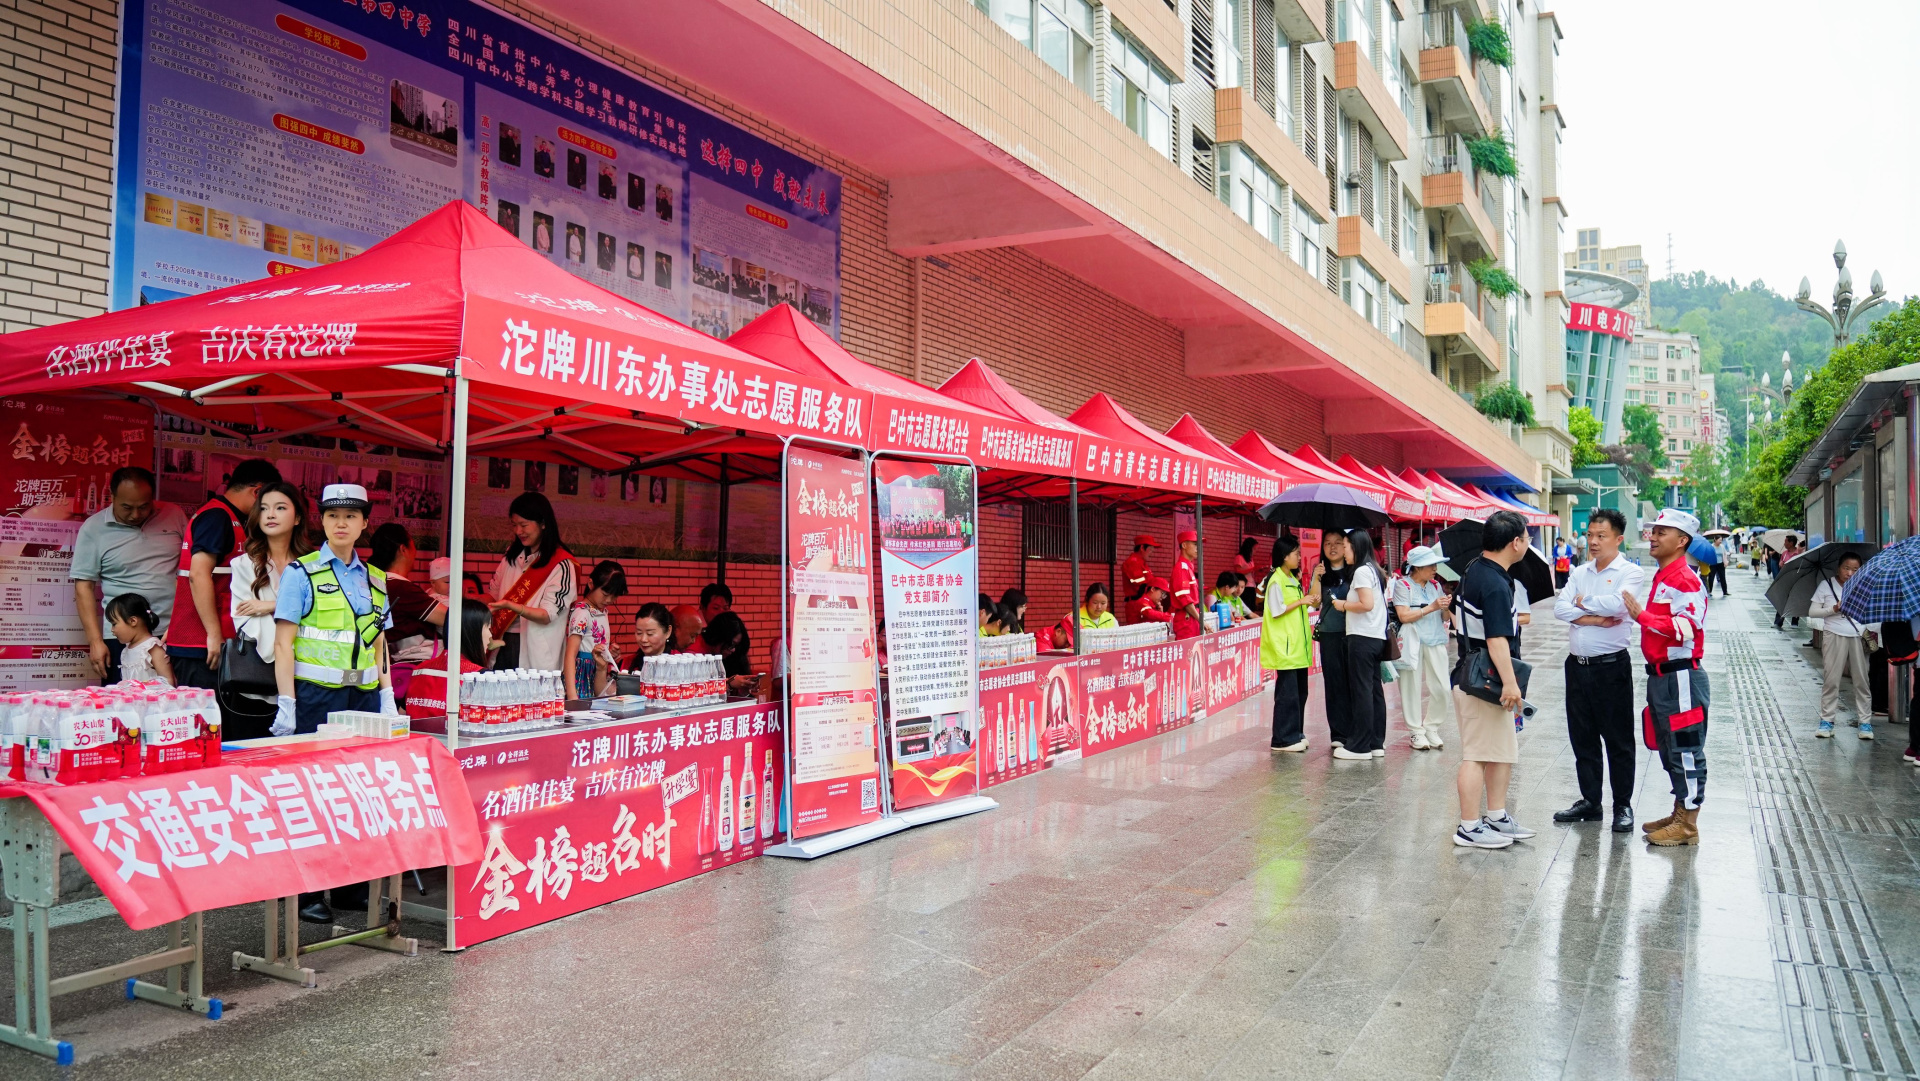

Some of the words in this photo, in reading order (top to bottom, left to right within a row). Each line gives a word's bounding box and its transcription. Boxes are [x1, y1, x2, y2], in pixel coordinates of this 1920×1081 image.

[304, 26, 341, 50] 学校概况
[342, 0, 431, 37] 第四中学
[448, 18, 687, 134] 四川省首批中小学心理健康教育引领校
[448, 46, 687, 158] 四川省中小学跨学科主题学习教师研修实践基地
[279, 116, 319, 138] 图强四中
[322, 128, 359, 152] 成绩斐然
[700, 138, 764, 189] 选择四中
[773, 168, 830, 217] 成就未来
[46, 329, 176, 379] 名酒伴佳宴
[200, 322, 358, 365] 吉庆有沱牌
[500, 317, 863, 440] 沱牌川东办事处志愿服务队
[8, 422, 135, 468] 金榜题名时
[888, 408, 970, 454] 巴中市志愿服务联合会
[980, 425, 1074, 469] 巴中市志愿者协会党员志愿服务队
[14, 478, 65, 493] 沱牌百万
[1085, 444, 1199, 487] 巴中市青年志愿者协会
[20, 493, 69, 506] 助学好礼
[796, 477, 860, 522] 金榜题名时
[801, 532, 827, 546] 沱牌百万
[891, 573, 963, 588] 巴中市志愿者协会
[904, 589, 950, 604] 党支部简介
[296, 645, 341, 661] POLICE
[1123, 644, 1184, 670] 巴中市青年志愿者协会
[73, 718, 106, 731] 农夫山泉
[160, 716, 189, 728] 农夫山泉
[571, 708, 782, 769] 沱牌川东办事处志愿服务队
[1085, 692, 1150, 746] 金榜题名时
[481, 775, 577, 821] 名酒伴佳宴
[584, 758, 666, 800] 吉庆有沱牌
[79, 752, 449, 884] 交通安全宣传服务点
[469, 803, 679, 921] 金榜题名时
